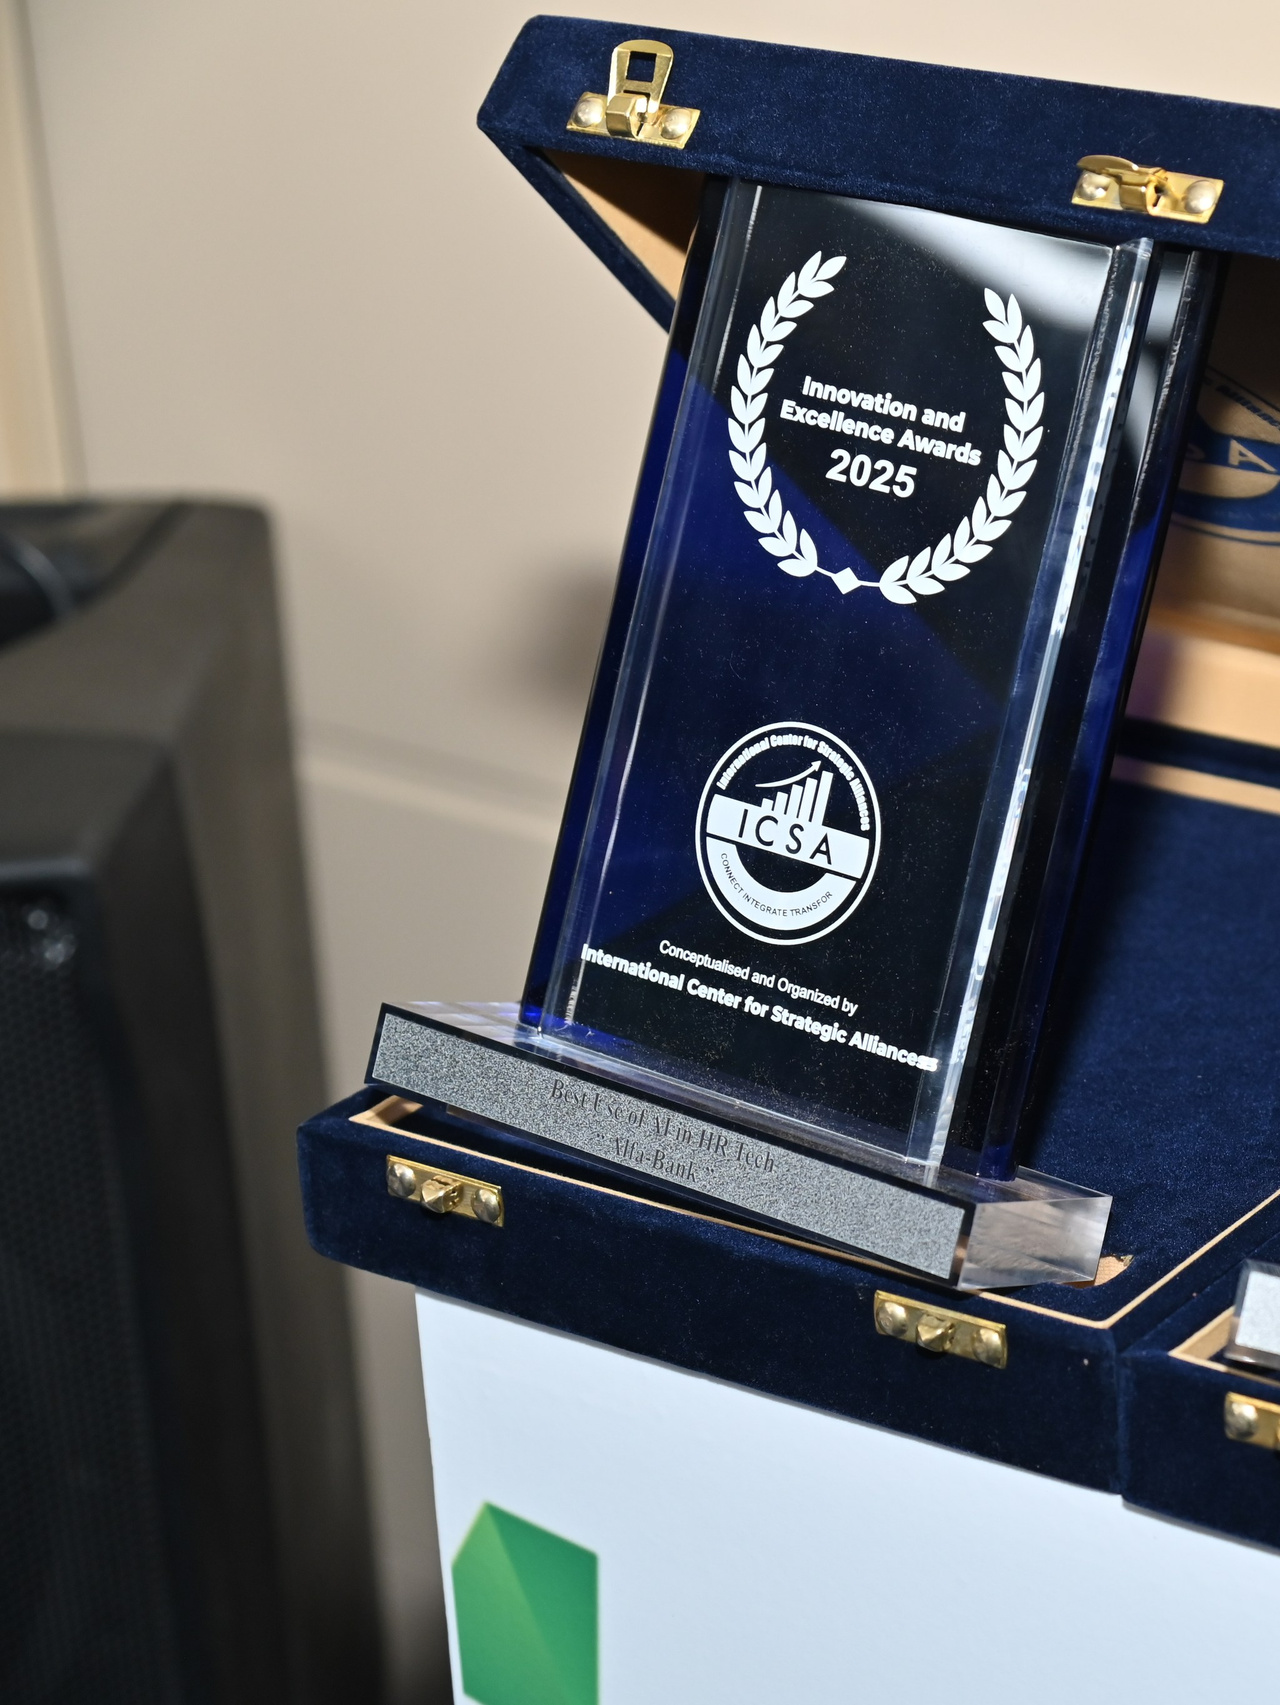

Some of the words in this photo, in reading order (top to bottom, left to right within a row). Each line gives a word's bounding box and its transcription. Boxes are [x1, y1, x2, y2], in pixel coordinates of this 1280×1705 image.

[779, 399, 895, 445] Excellence
[897, 428, 982, 466] Awards
[801, 375, 917, 422] Innovation
[921, 411, 966, 433] and
[825, 448, 917, 498] 2025
[738, 808, 833, 866] ICSA
[721, 852, 745, 894] CONNECT
[742, 892, 788, 917] INTEGRATE
[790, 891, 833, 917] TRANSFOR
[580, 943, 684, 992] International
[686, 978, 742, 1010] Center
[744, 995, 769, 1018] for
[770, 1004, 847, 1045] Strategic
[659, 939, 750, 981] Conceptualised
[751, 969, 775, 990] and
[777, 977, 841, 1008] Organized
[841, 997, 858, 1018] by
[551, 1078, 588, 1108] Best
[628, 1108, 648, 1130] of
[675, 1125, 692, 1146] in
[698, 1128, 730, 1158] HR
[733, 1141, 776, 1174] Tech
